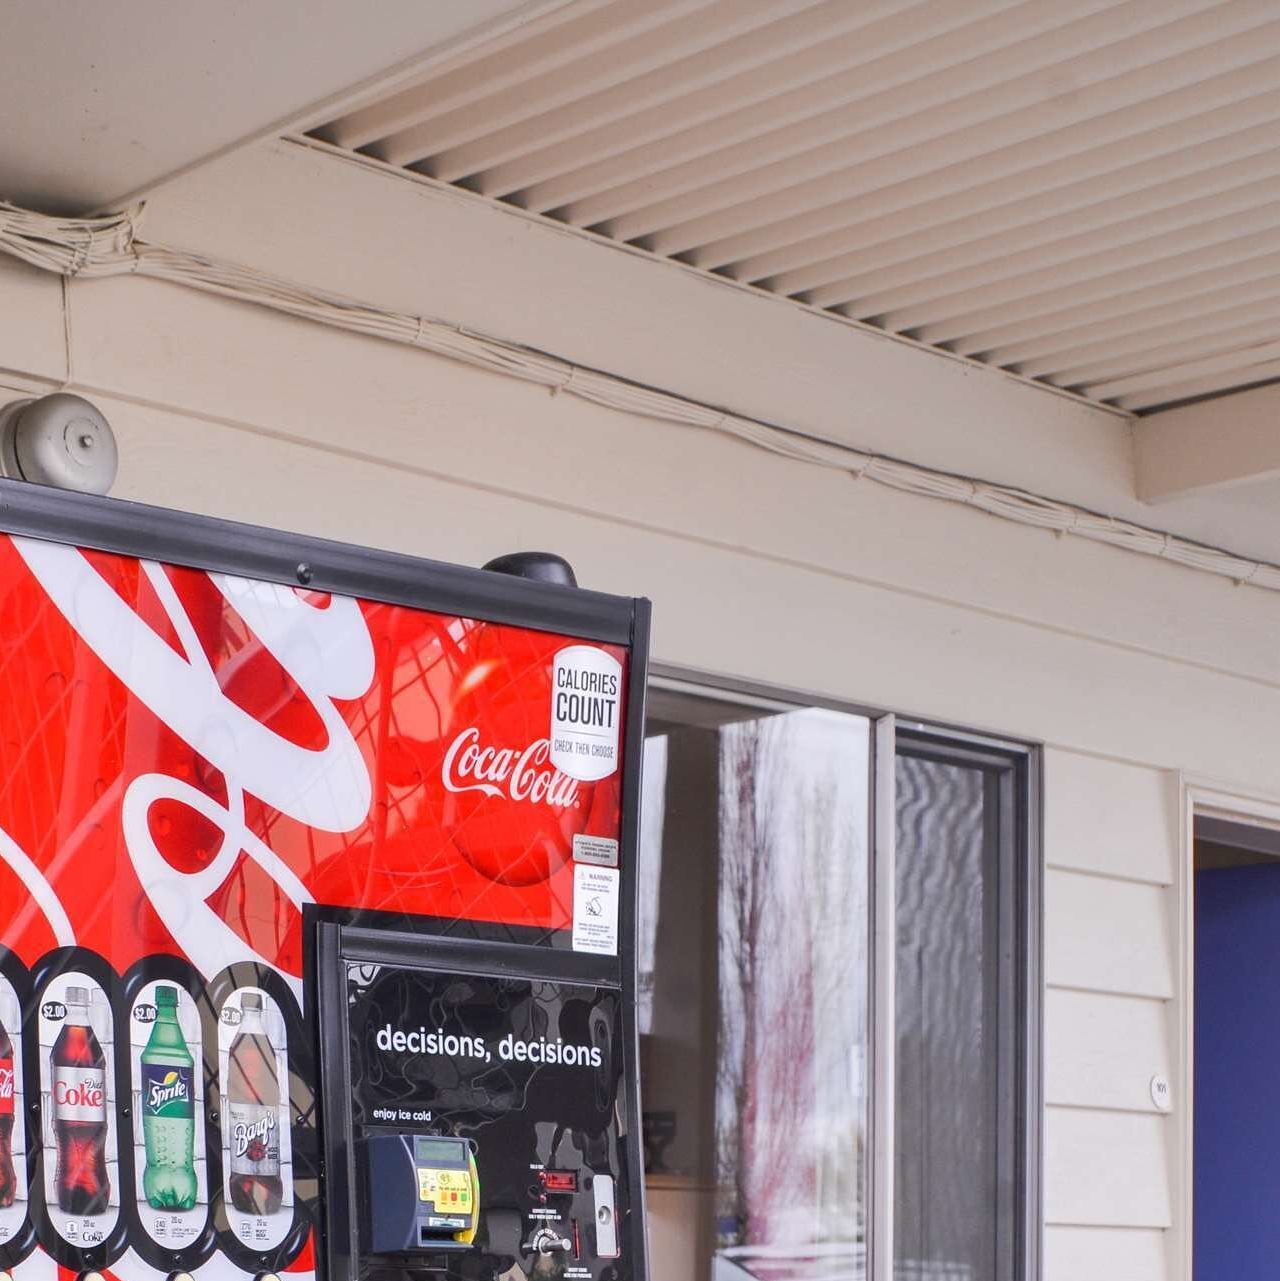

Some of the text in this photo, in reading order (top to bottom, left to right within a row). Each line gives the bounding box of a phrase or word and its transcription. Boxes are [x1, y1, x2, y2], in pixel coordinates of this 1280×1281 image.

[557, 667, 617, 696] CALORIES
[555, 693, 616, 729] COUNT
[554, 739, 614, 759] CHECK THEN CHOOSE
[43, 1006, 66, 1018] $2.00
[134, 1007, 156, 1020] $2.00
[220, 1010, 241, 1022] $2.00
[376, 1024, 602, 1067] decisions, decisions
[53, 1080, 104, 1108] Coke
[84, 1078, 104, 1089] Diet
[149, 1080, 186, 1107] Sprite
[373, 1109, 432, 1122] enjoy ice cold
[234, 1111, 275, 1157] Barq's
